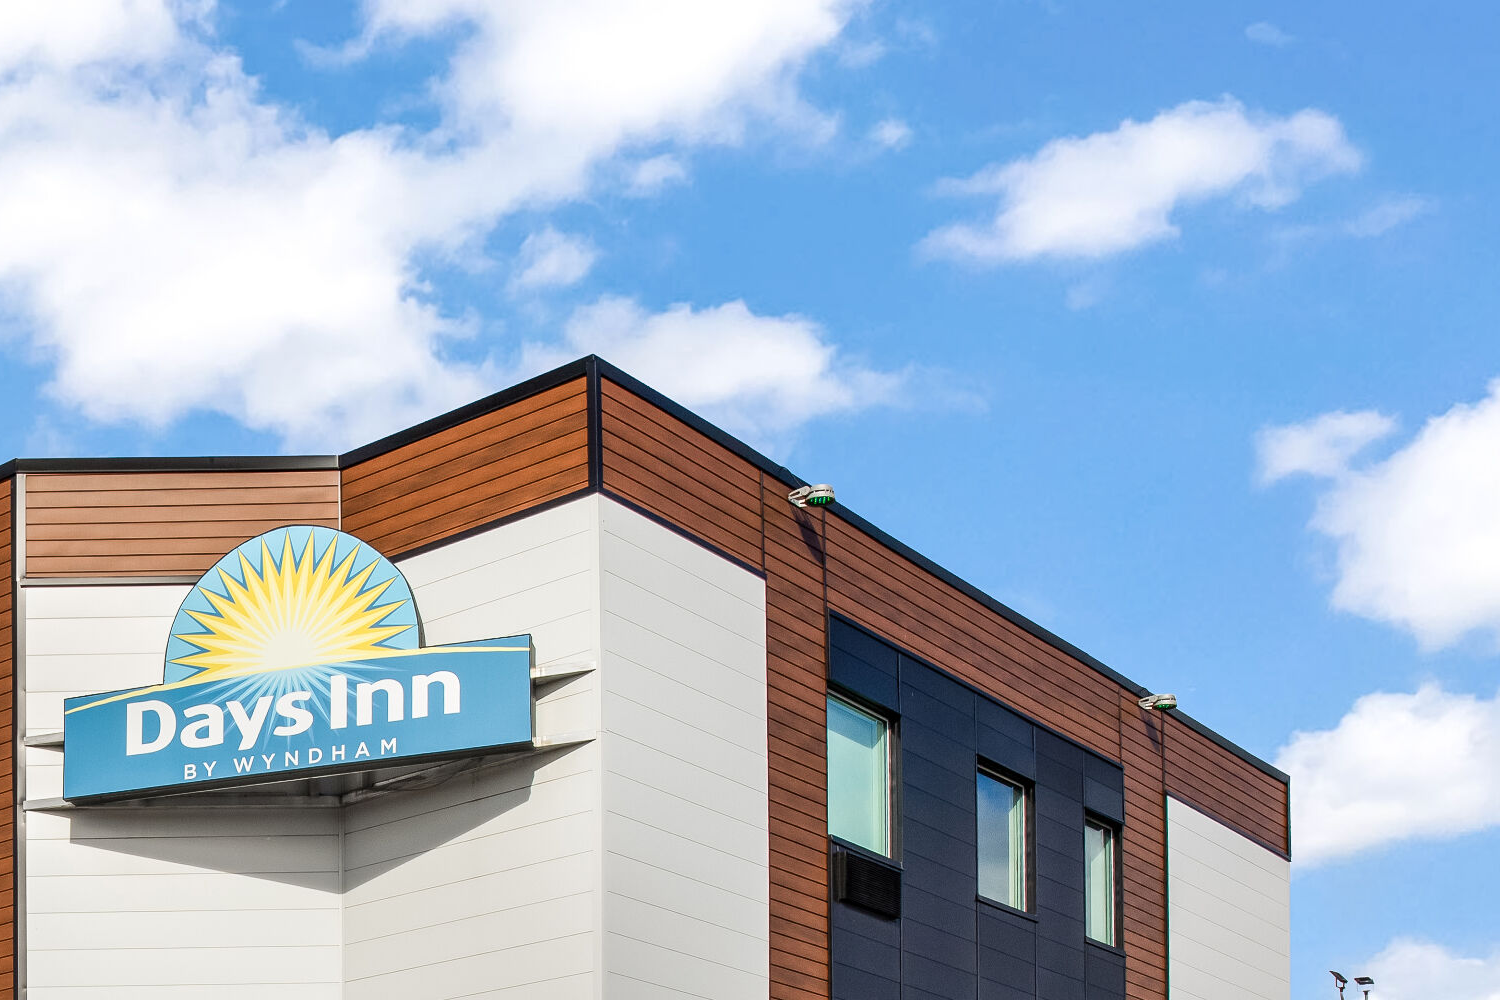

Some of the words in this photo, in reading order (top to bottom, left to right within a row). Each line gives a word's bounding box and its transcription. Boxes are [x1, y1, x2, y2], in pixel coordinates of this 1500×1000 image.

[125, 688, 314, 757] Days
[329, 669, 462, 730] Inn
[183, 759, 218, 781] BY
[233, 736, 399, 775] WYNDHAM
